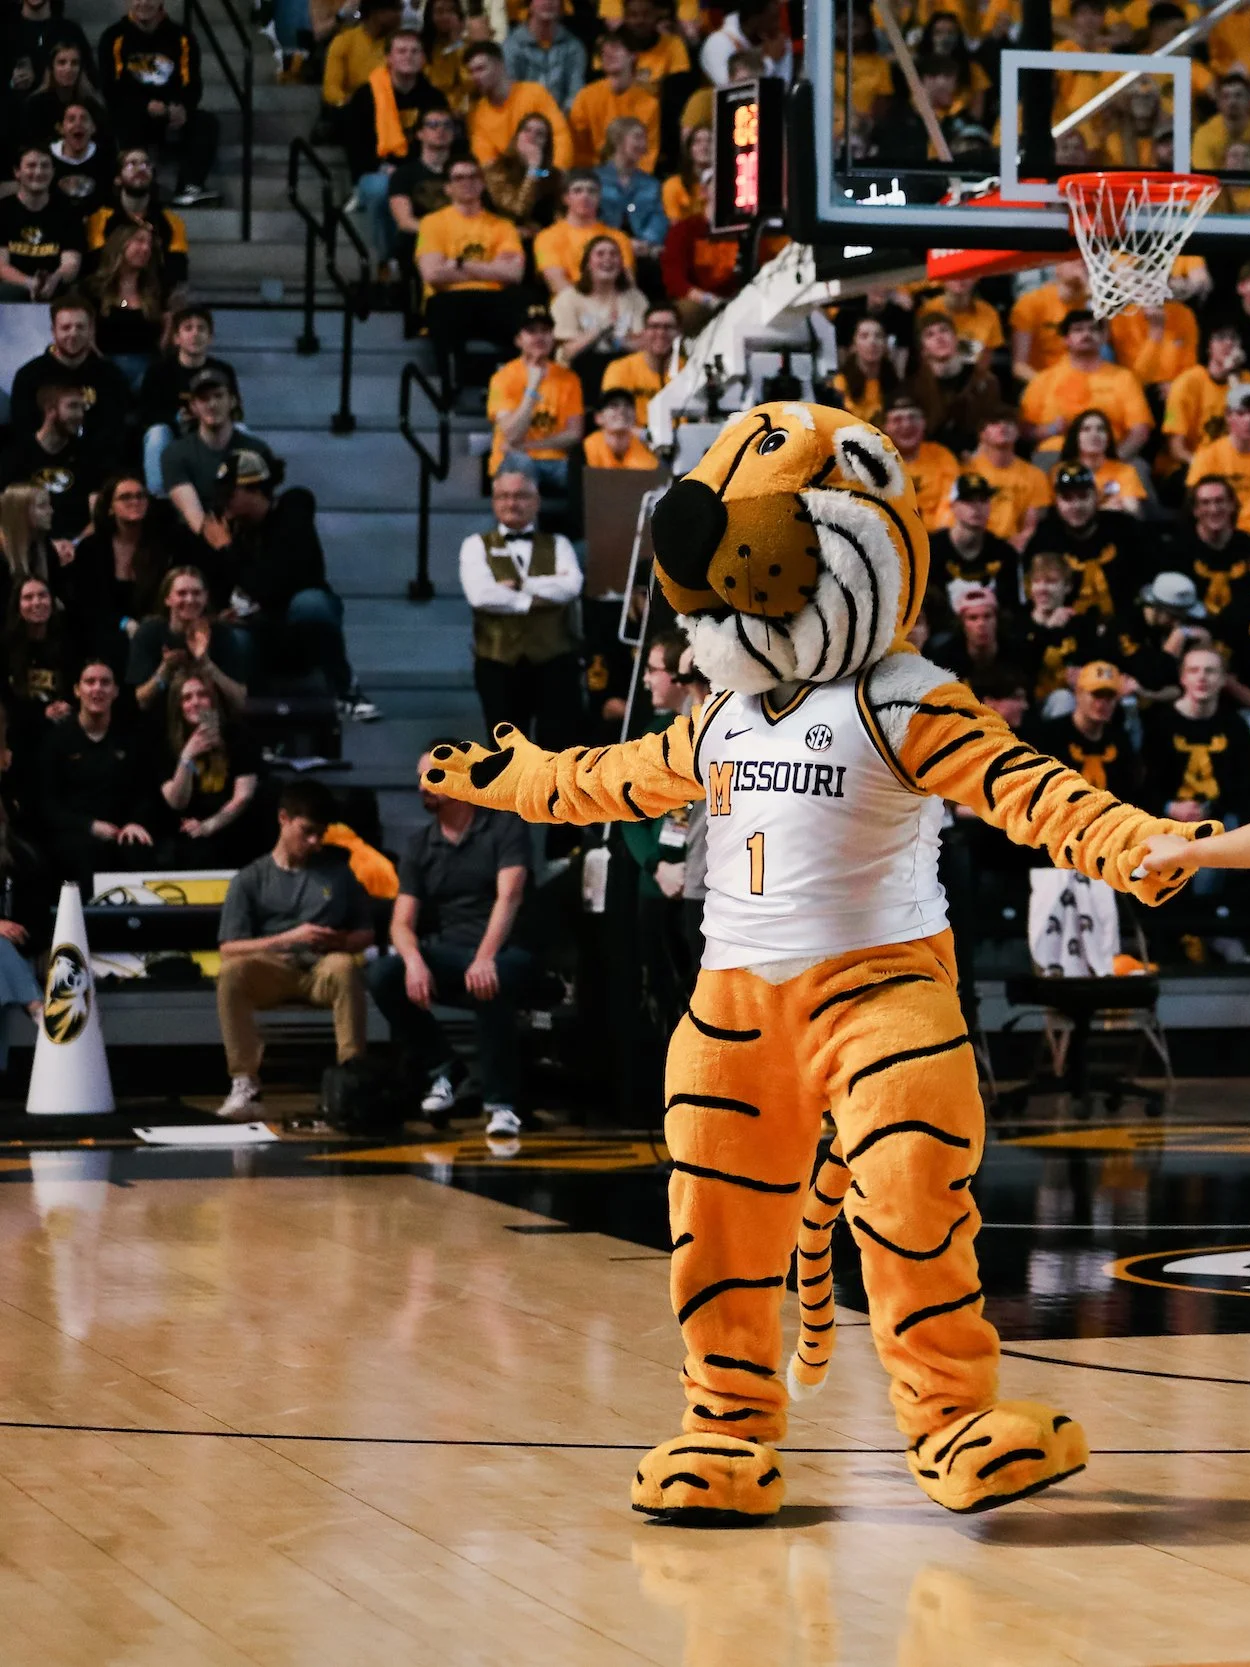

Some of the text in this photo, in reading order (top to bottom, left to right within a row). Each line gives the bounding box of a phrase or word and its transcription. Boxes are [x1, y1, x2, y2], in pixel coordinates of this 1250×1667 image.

[806, 725, 832, 750] SEC
[710, 761, 846, 816] MISSOURI
[746, 832, 764, 895] 1
